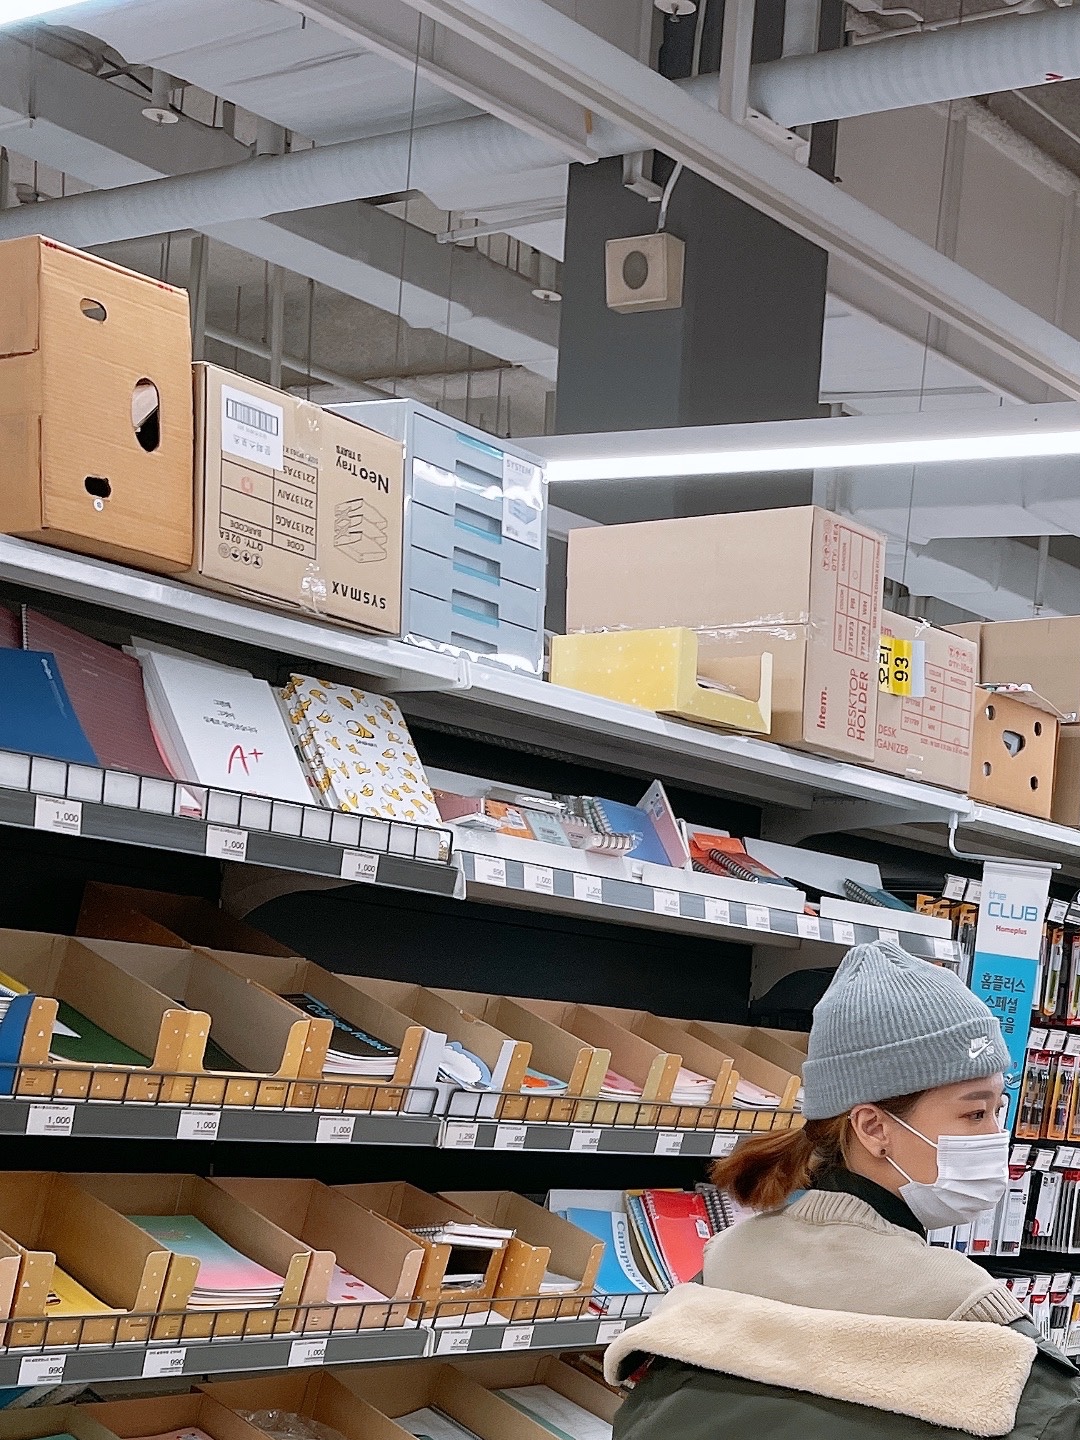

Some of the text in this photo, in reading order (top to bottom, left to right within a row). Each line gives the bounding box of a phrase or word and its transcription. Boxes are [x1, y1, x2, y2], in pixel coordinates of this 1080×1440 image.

[230, 519, 262, 537] BARCODE
[275, 514, 314, 536] 22137ACG
[286, 539, 305, 552] CODE
[332, 580, 387, 610] SYSMAX
[894, 657, 909, 682] 93
[847, 668, 862, 739] DESKTOP
[856, 671, 869, 742] HOLDER
[878, 724, 897, 738] DESK
[875, 738, 909, 755] GANIZER
[227, 744, 264, 776] A+
[55, 811, 79, 823] 1,000
[223, 840, 245, 851] 1,000
[356, 863, 376, 873] 1,000
[988, 889, 1007, 900] the
[988, 901, 1038, 922] CLUB
[995, 925, 1028, 936] Homeplus
[980, 972, 1026, 994] 홈플러스
[984, 995, 1019, 1014] 스페셜
[47, 1115, 71, 1125] 1,000
[195, 1121, 217, 1130] 1,000
[332, 1126, 352, 1134] 1,000
[616, 1219, 637, 1279] Campus
[306, 1348, 326, 1357] 1,000
[169, 1358, 185, 1367] 990
[48, 1366, 64, 1375] 990
